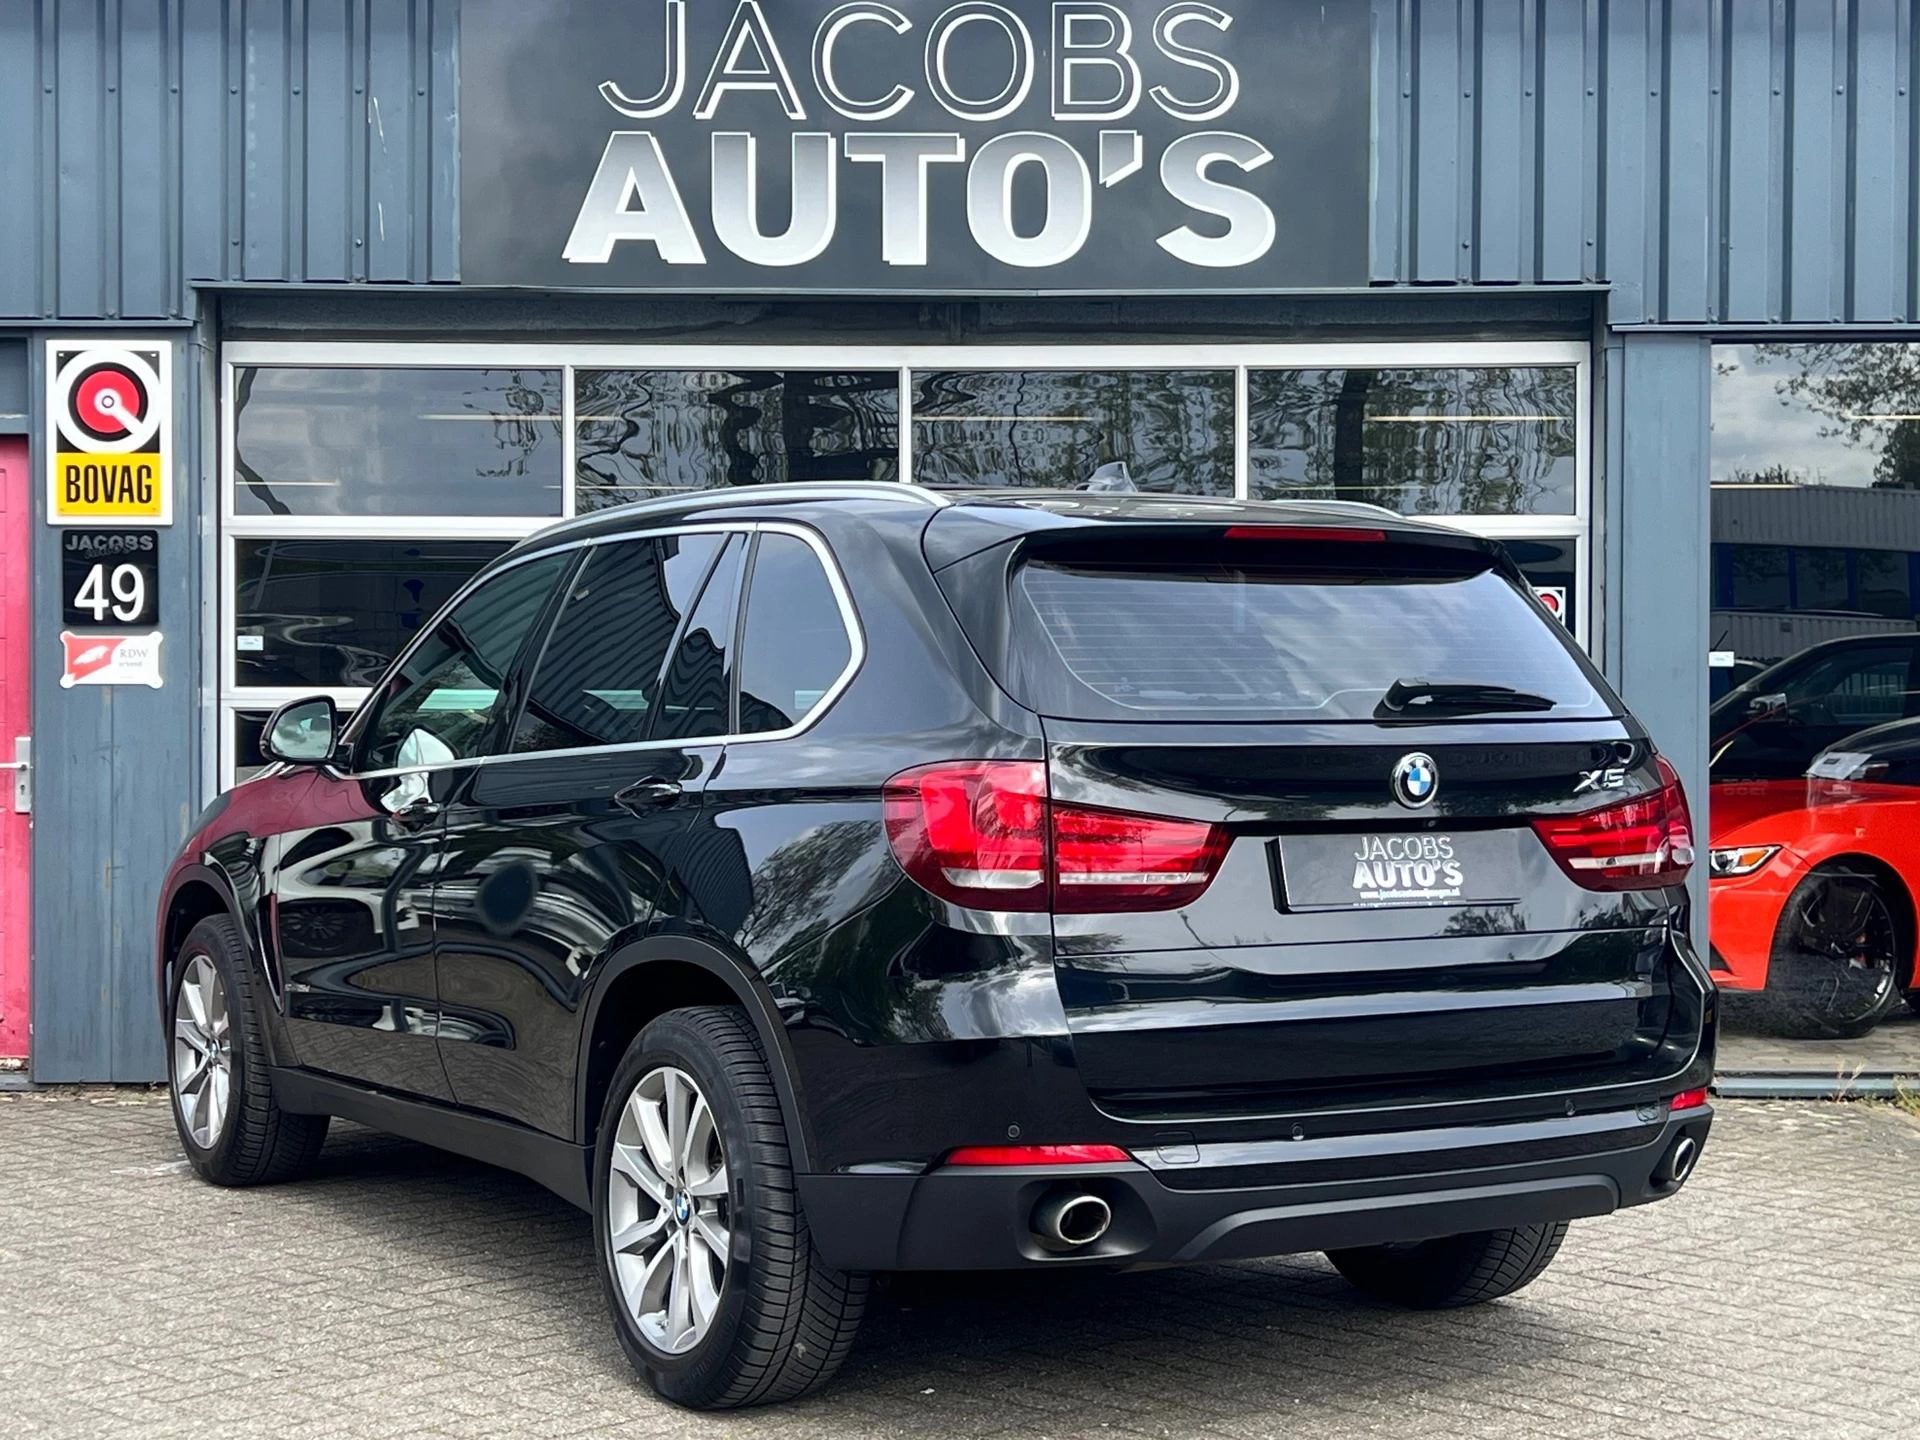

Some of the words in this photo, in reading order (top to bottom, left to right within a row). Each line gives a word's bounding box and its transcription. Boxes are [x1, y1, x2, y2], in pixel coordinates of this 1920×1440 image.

[598, 0, 1240, 121] JACOBS
[562, 130, 1277, 267] AUTO'S
[65, 464, 153, 504] BOVAG
[65, 535, 154, 551] JACOBS
[74, 563, 145, 622] 49
[119, 648, 149, 659] RDW
[1573, 768, 1626, 793] X5
[1354, 835, 1454, 861] JACOBS
[1352, 859, 1464, 889] AUTO'S
